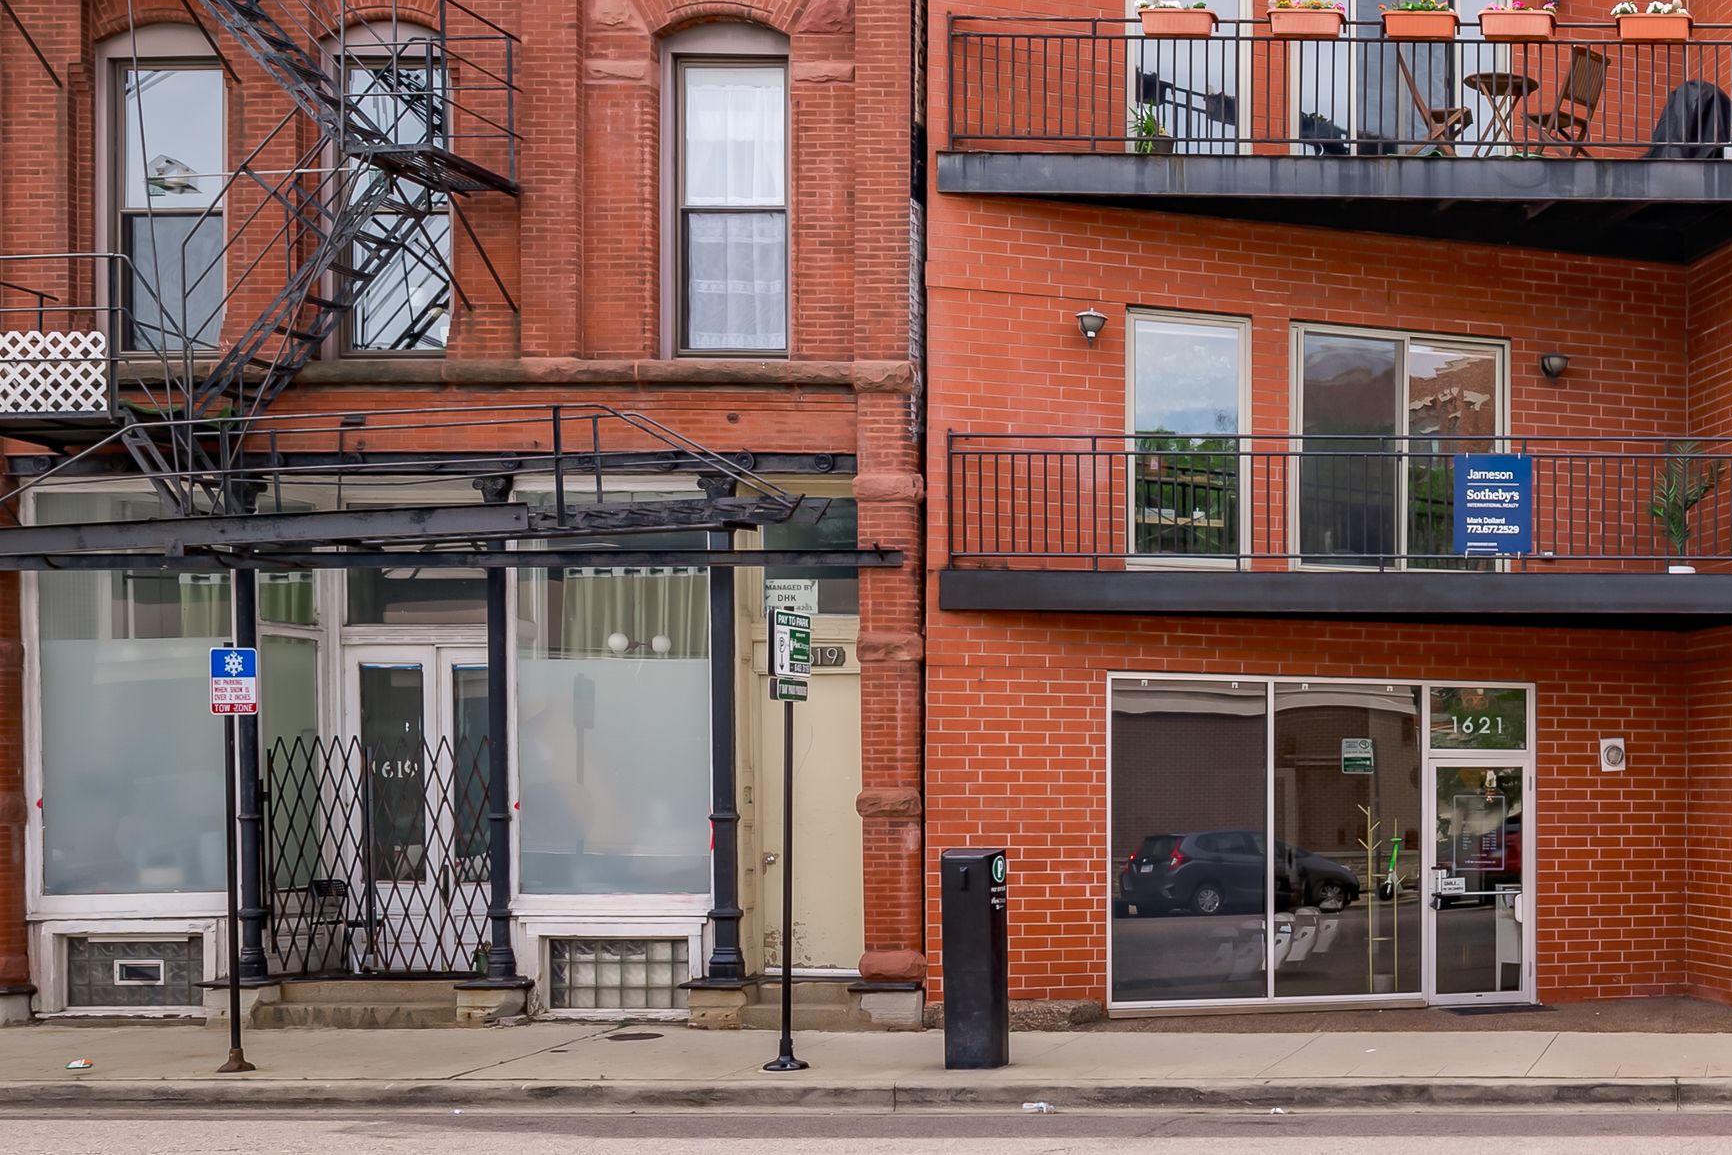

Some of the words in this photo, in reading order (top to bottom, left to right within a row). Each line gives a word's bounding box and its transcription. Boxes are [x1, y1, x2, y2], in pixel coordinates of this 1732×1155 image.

[1466, 468, 1513, 480] Jameson
[1466, 488, 1520, 502] Sotheby's
[1466, 525, 1520, 534] 773.677.2529
[777, 594, 797, 602] DHK
[777, 614, 788, 625] PAY
[788, 615, 796, 626] TO
[796, 616, 809, 628] PARK
[214, 704, 231, 712] TOW
[233, 704, 254, 712] ZONE
[1451, 716, 1502, 734] 1621
